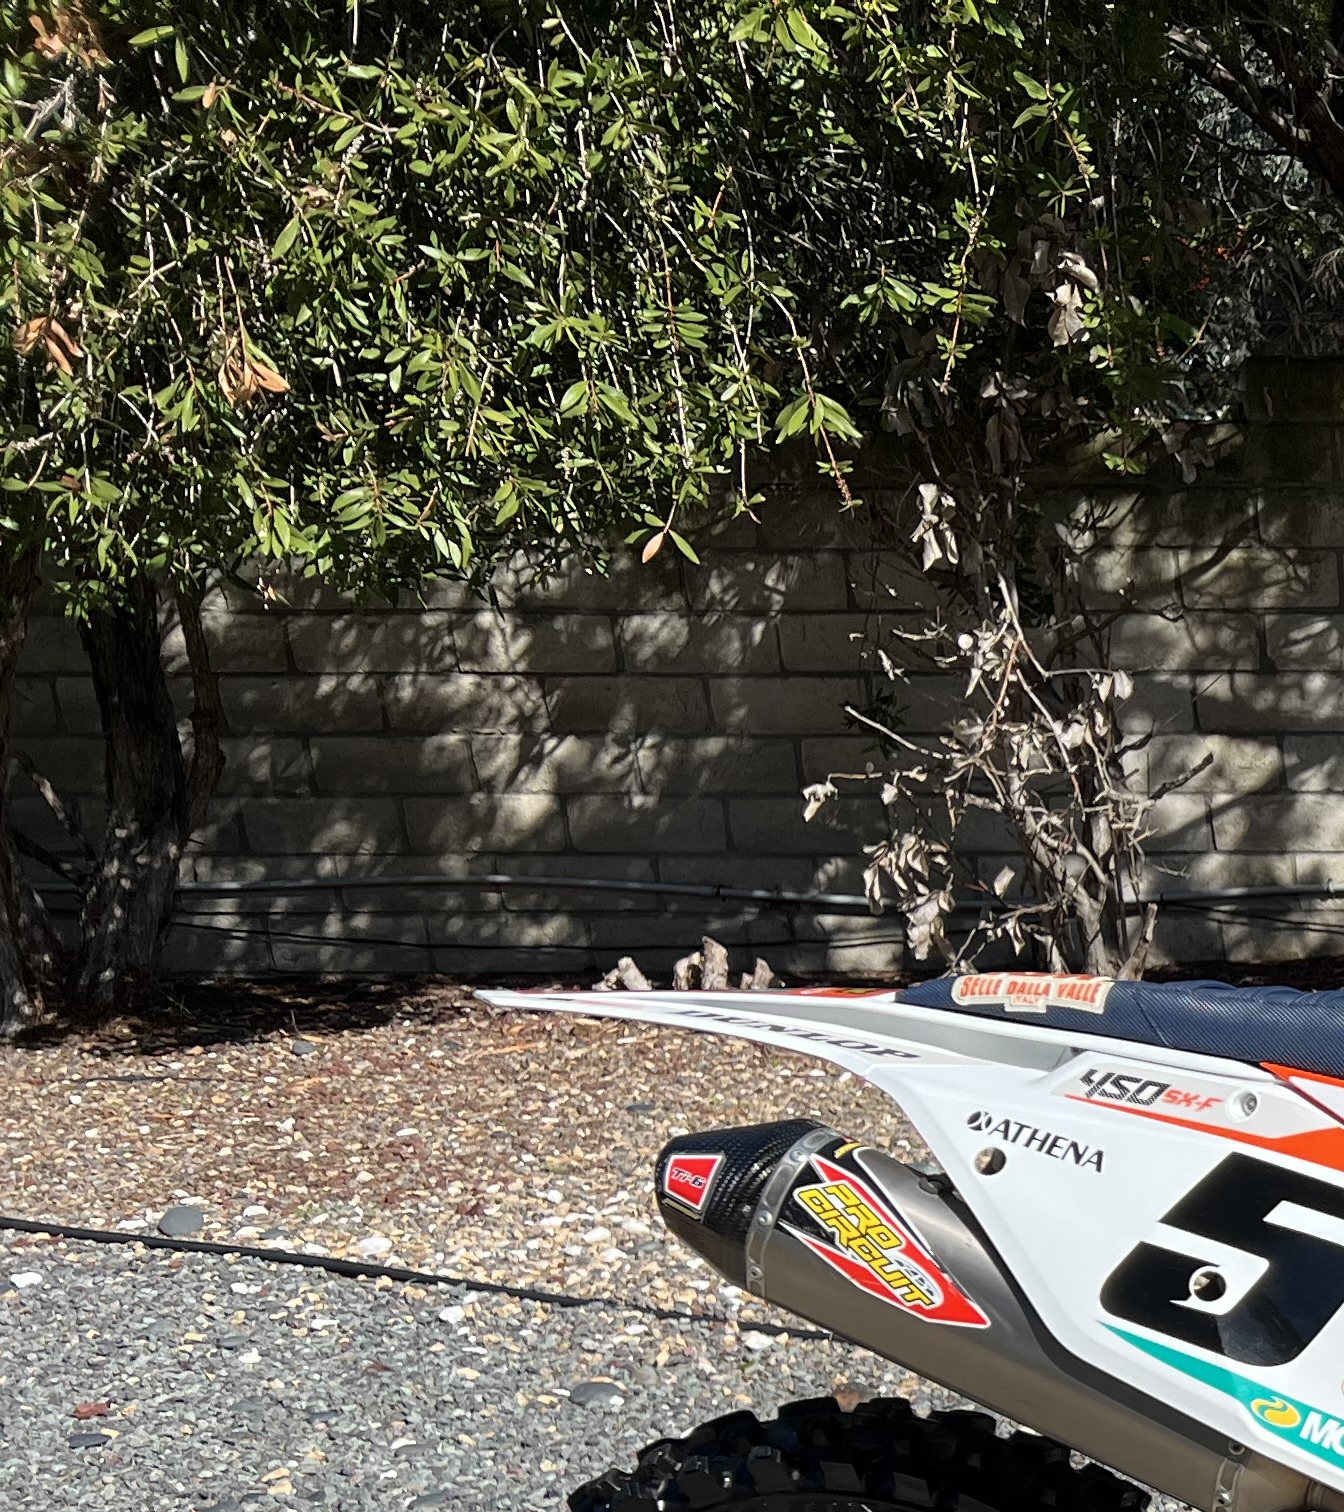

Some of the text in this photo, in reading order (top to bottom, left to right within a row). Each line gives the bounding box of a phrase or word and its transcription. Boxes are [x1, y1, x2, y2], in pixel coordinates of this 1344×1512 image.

[961, 977, 1103, 1004] SELLE DALLA VALLE
[677, 1010, 920, 1059] DUNLOP
[1079, 1069, 1223, 1112] 450 SX-F
[988, 1118, 1105, 1173] ATHENA
[822, 1184, 902, 1250] PRO
[798, 1188, 935, 1307] CIRCUIT
